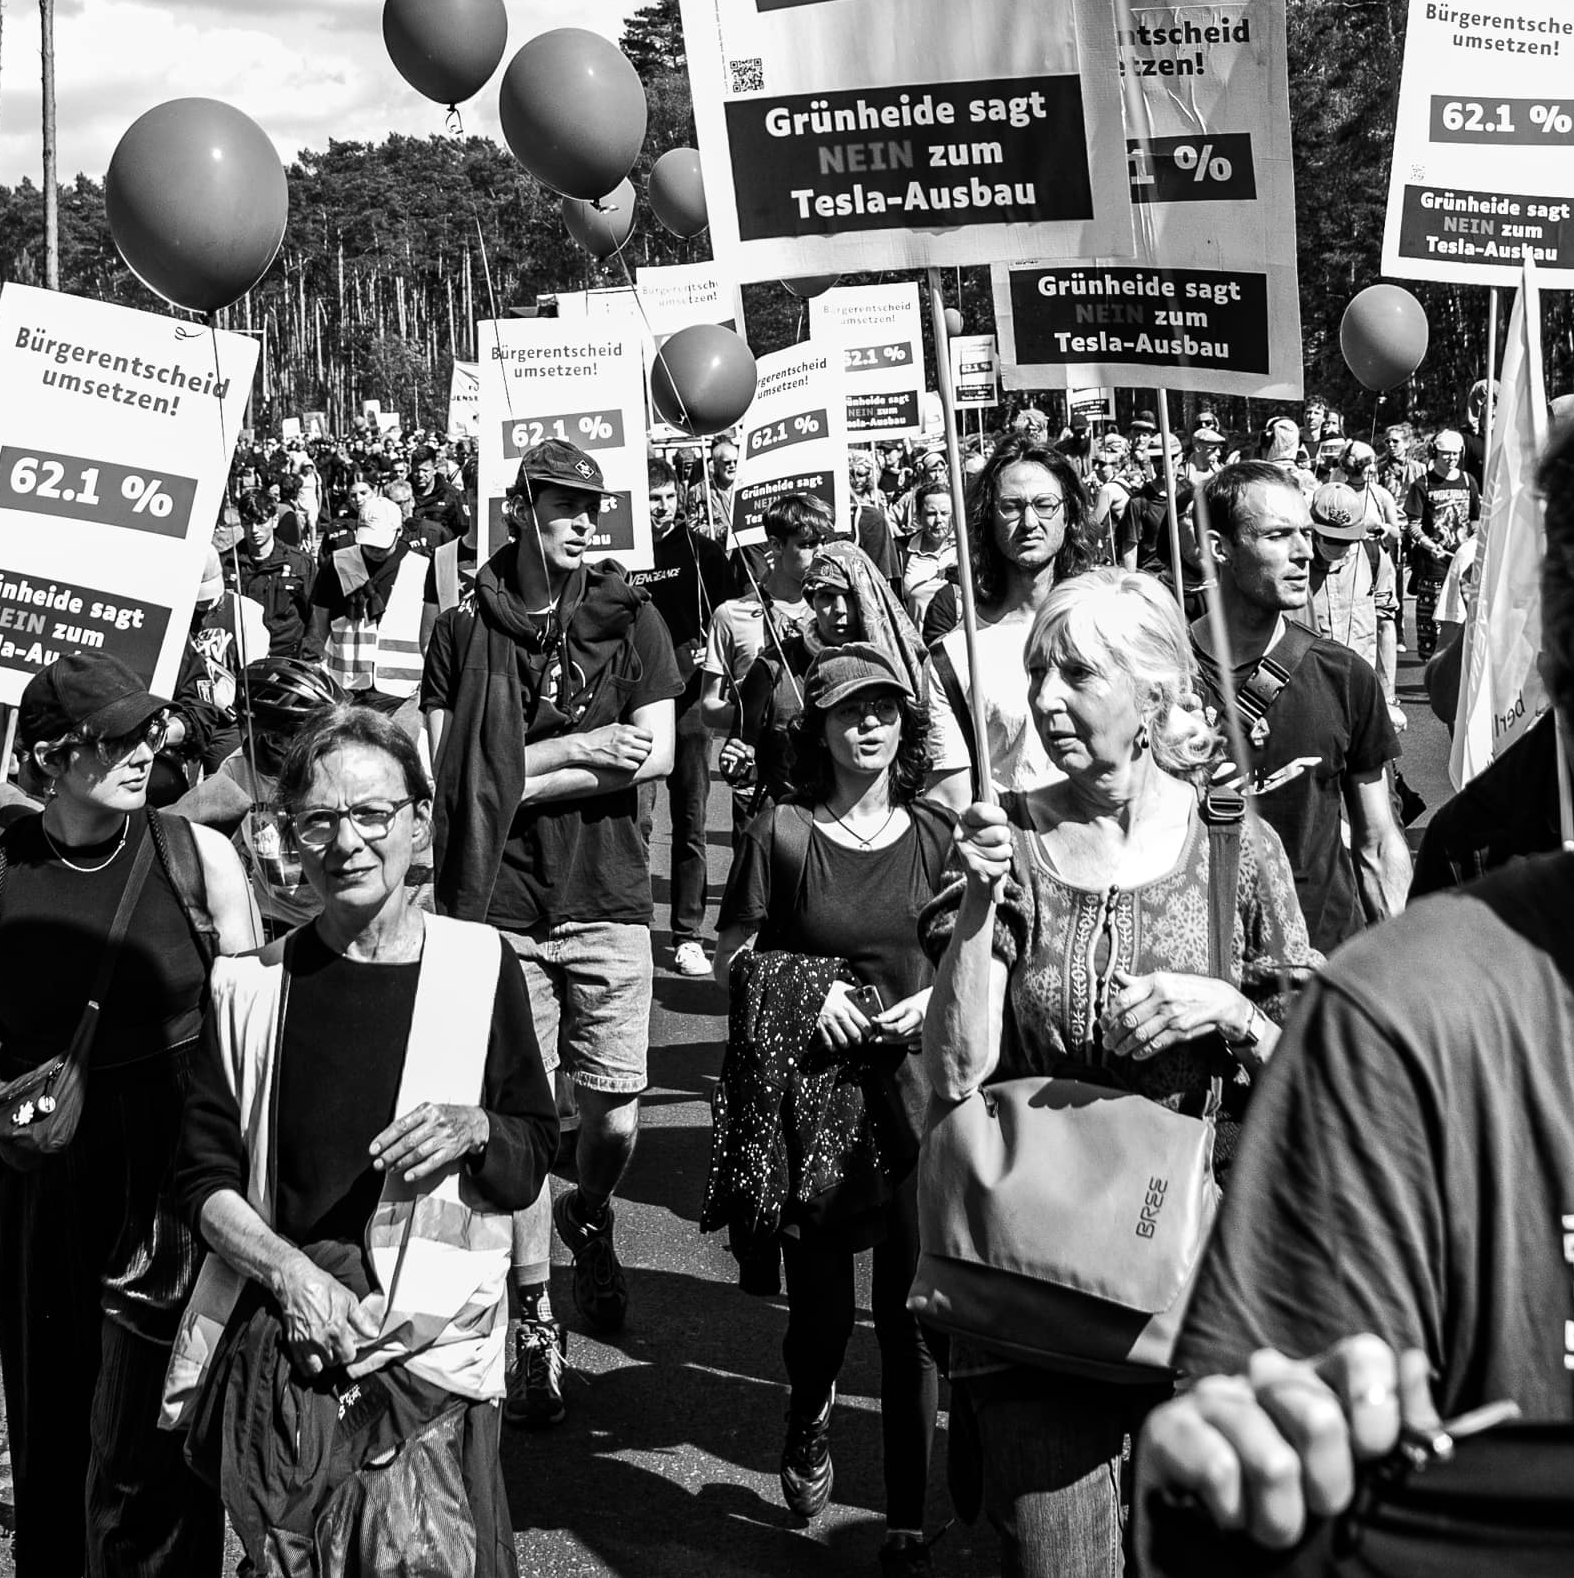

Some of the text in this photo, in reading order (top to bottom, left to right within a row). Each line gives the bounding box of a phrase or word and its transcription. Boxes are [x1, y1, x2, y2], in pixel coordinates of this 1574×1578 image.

[1118, 16, 1250, 46] ntscheid
[1452, 33, 1560, 56] umsetzen!
[765, 91, 1047, 137] Grünheide sagt
[1442, 101, 1573, 134] 62.1 %
[818, 139, 1003, 175] NEIN zum
[1174, 144, 1233, 182] %
[791, 177, 1036, 219] Tesla-Ausbau
[1420, 191, 1570, 222] Grünheide sagt
[1443, 215, 1543, 238] NEIN zum
[1037, 273, 1241, 305] Grünheide sagt
[1075, 304, 1208, 327] NEIN zum
[491, 342, 623, 362] Bürgerentscheid
[883, 345, 906, 362] %
[1054, 331, 1229, 358] Tesla-Ausbau
[15, 326, 230, 399] Bürgerentscheid
[514, 362, 598, 378] umsetzen!
[757, 358, 827, 388] rgerentscheid
[42, 369, 180, 417] umsetzen!
[757, 375, 809, 400] umsetzen!
[848, 407, 874, 417] NEIN
[511, 415, 613, 448] 62.1 %
[751, 415, 819, 449] 62.1 %
[9, 456, 174, 518] 62.1 %
[741, 475, 824, 500] Grünheide sagt
[89, 601, 145, 630] sagt
[52, 622, 105, 648] zum
[1136, 1176, 1168, 1239] BREE
